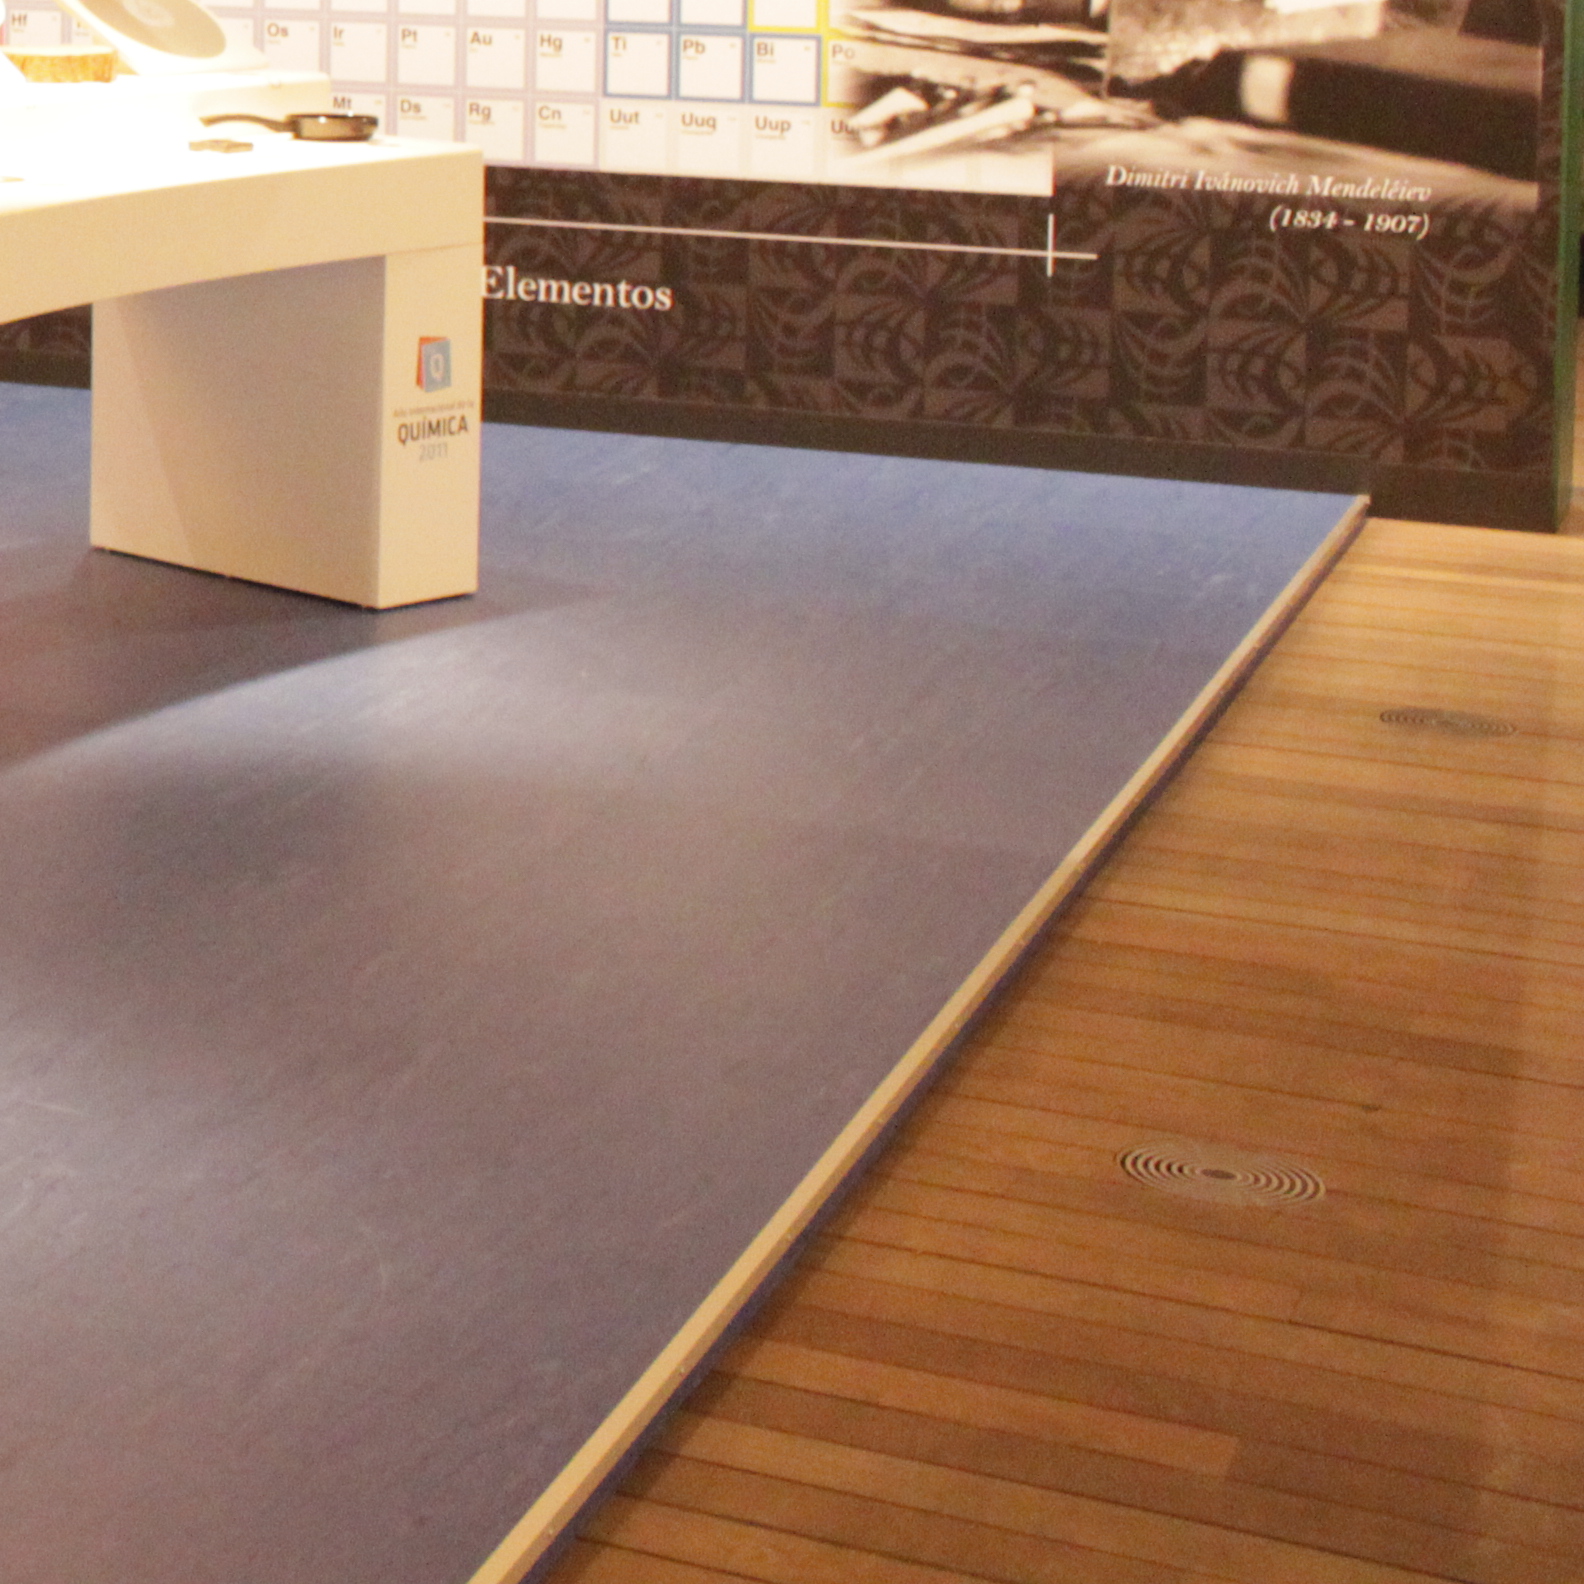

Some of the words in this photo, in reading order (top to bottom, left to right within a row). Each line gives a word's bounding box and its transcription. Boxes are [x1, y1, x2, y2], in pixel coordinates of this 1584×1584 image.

[683, 39, 706, 54] Pb
[682, 113, 717, 130] Uuq
[755, 116, 791, 133] Uup
[1105, 164, 1188, 189] Dimitri
[1194, 169, 1300, 195] Ivánovich
[1307, 175, 1432, 201] Mendeléiev
[1269, 205, 1339, 232] (1834
[1364, 212, 1430, 241] 1907)
[482, 265, 673, 310] Elementos
[397, 414, 469, 446] QUÍMICA
[419, 442, 449, 462] 2011
